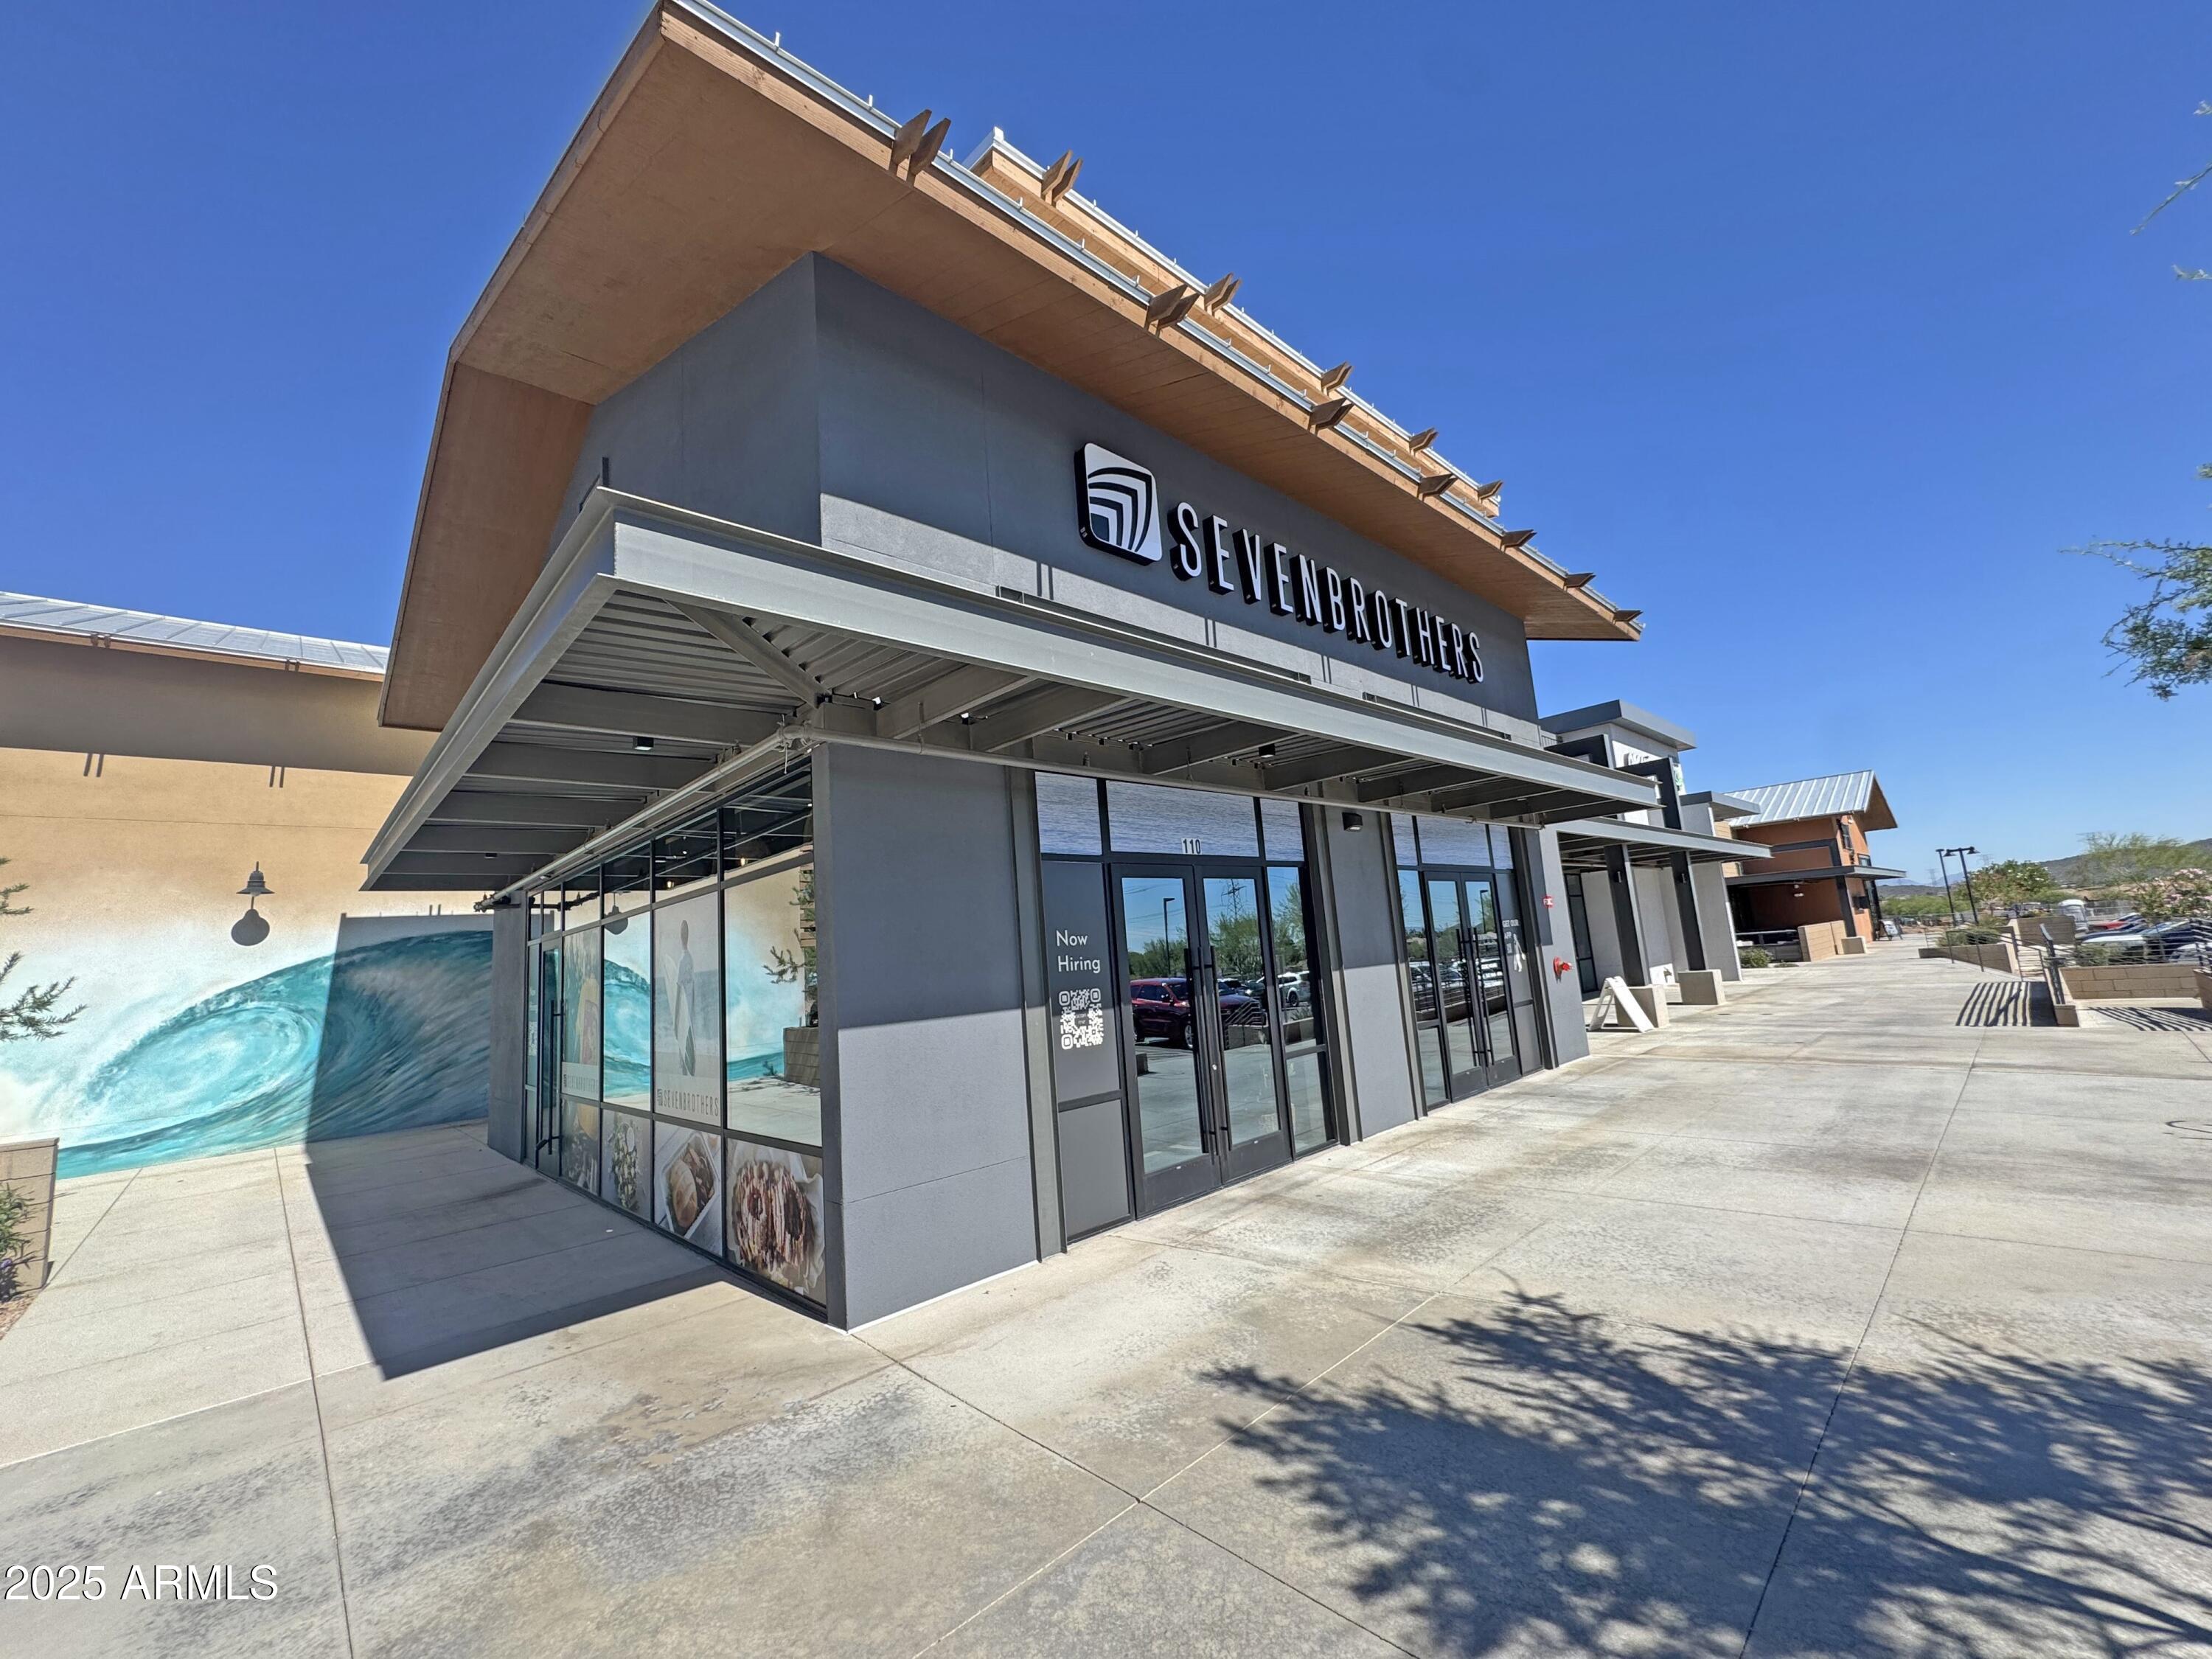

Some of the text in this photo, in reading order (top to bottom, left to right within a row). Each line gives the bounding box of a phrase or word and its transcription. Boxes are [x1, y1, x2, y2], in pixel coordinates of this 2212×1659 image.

[1170, 502, 1484, 684] SEVENBROTHERS
[1183, 838, 1201, 855] 110
[1056, 930, 1088, 947] Now
[1057, 955, 1101, 974] Hiring
[664, 1090, 719, 1116] SEVENBROTHERS
